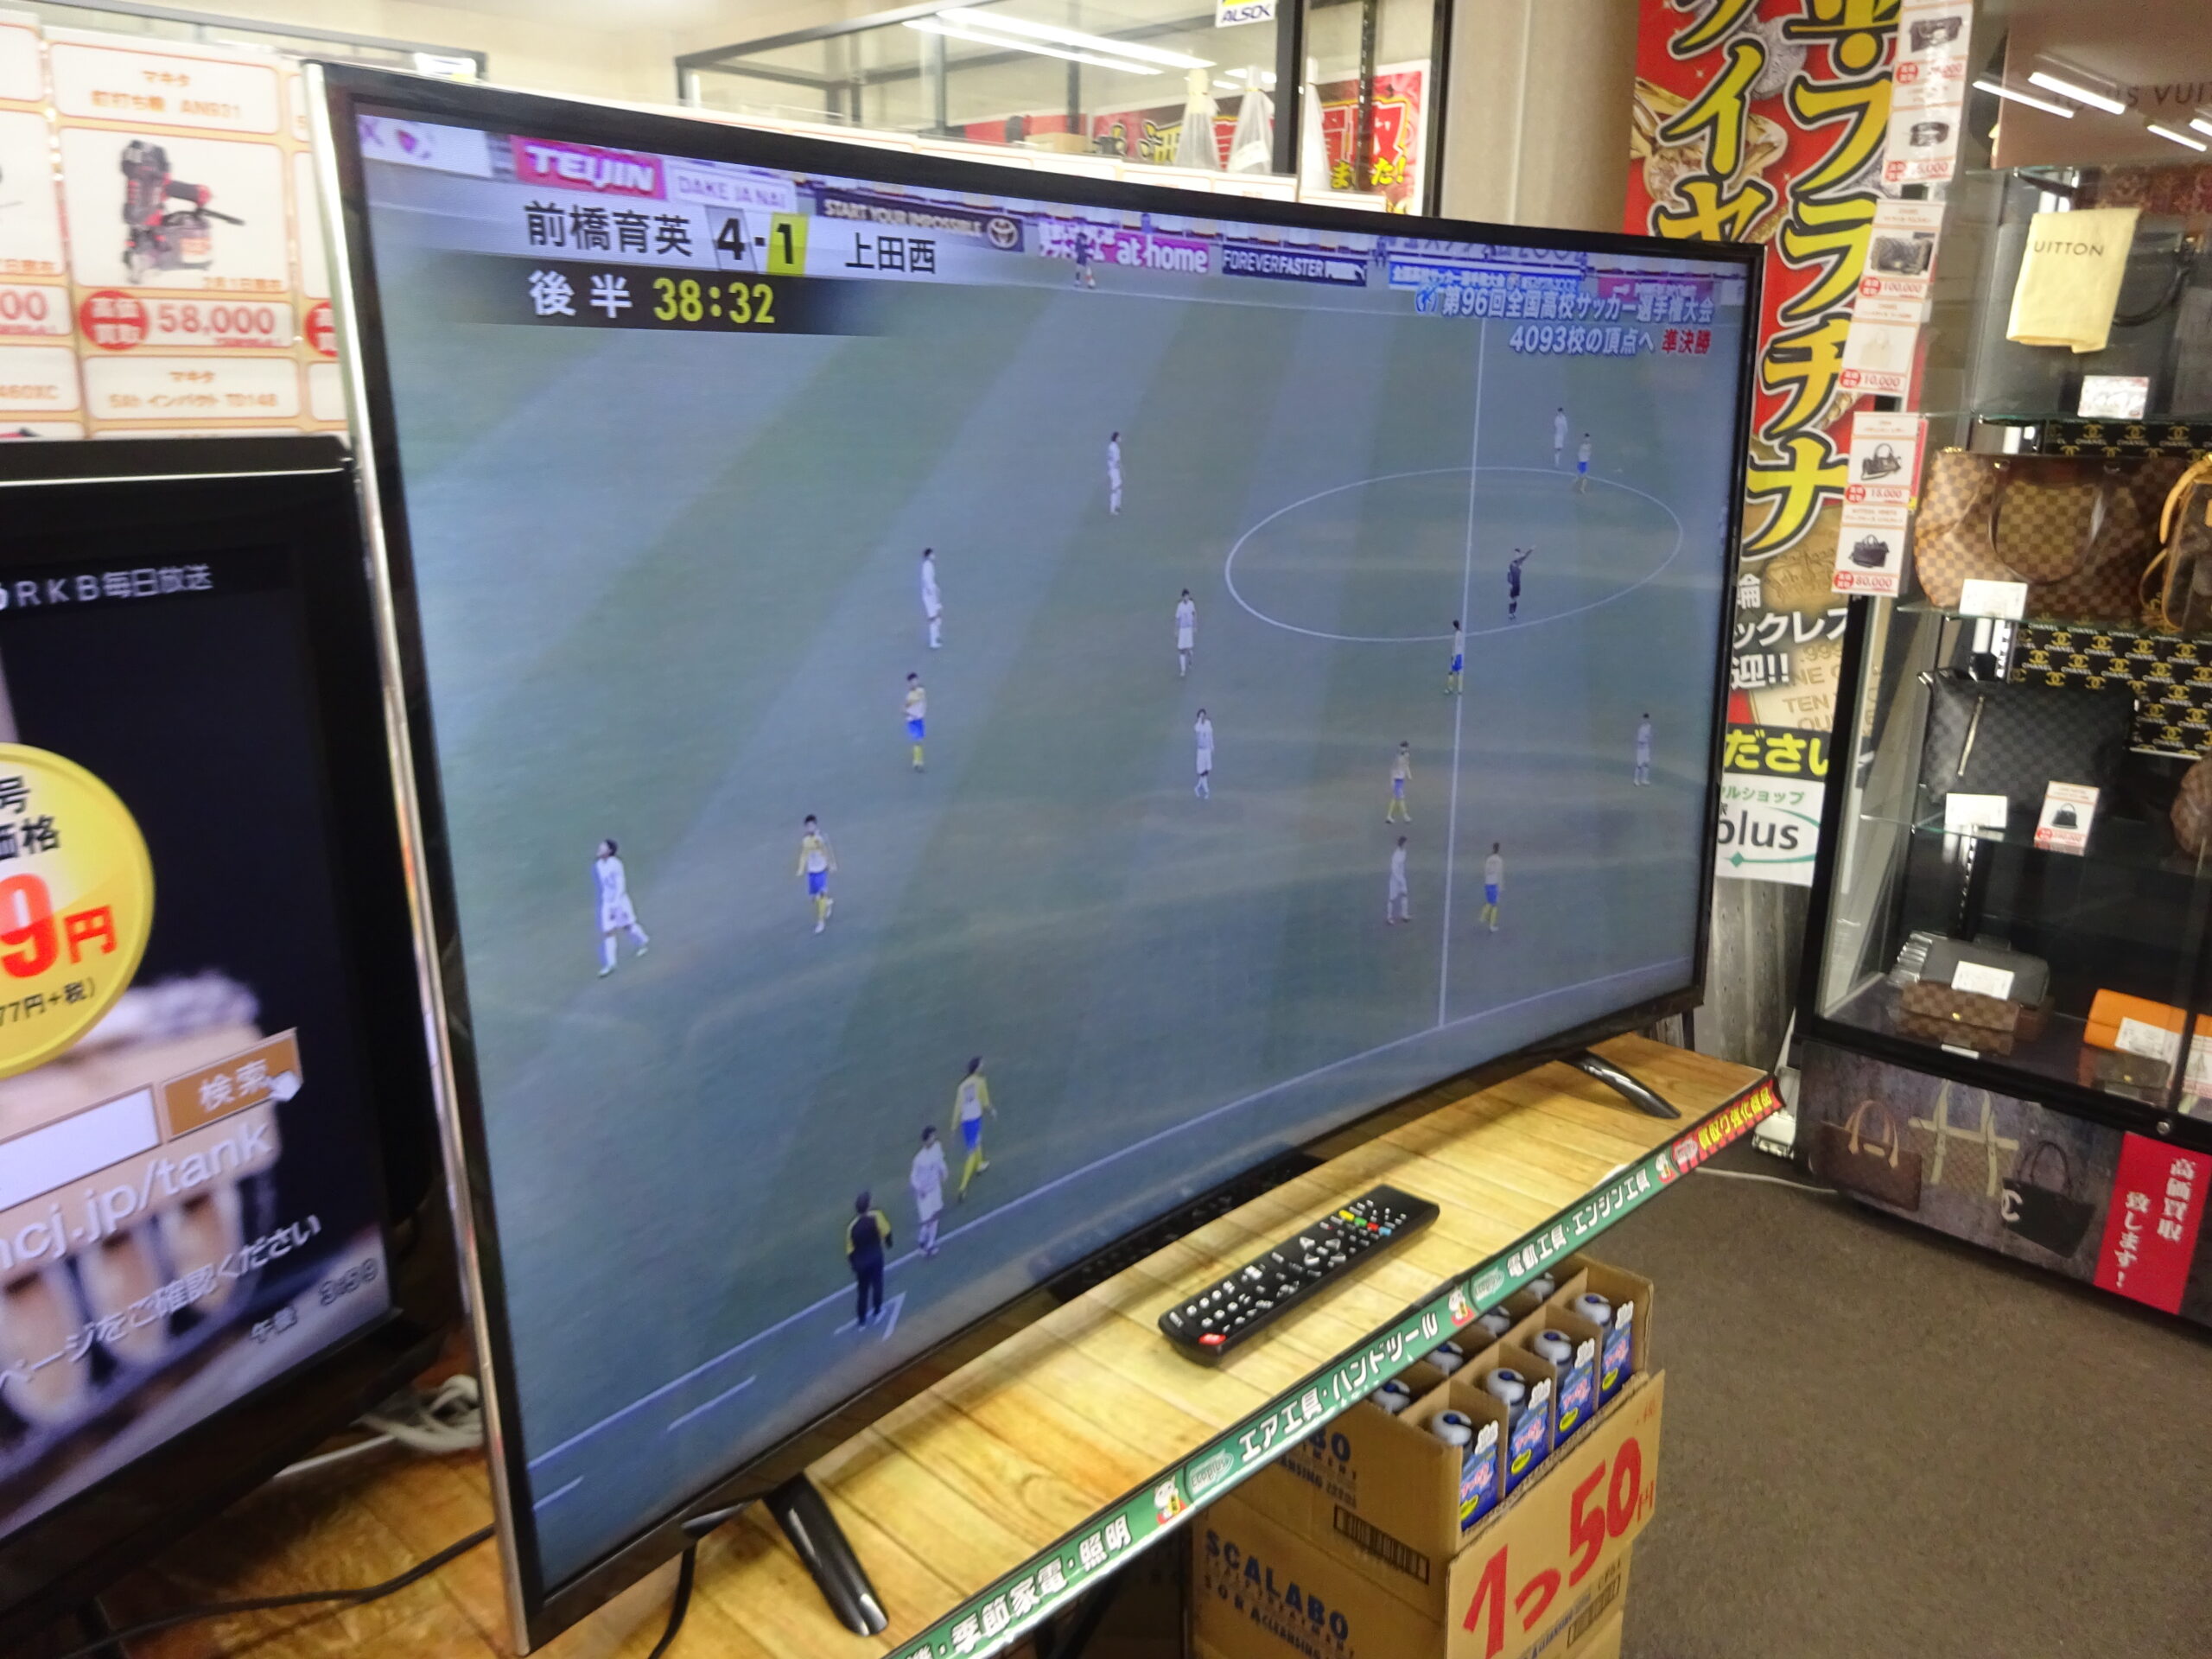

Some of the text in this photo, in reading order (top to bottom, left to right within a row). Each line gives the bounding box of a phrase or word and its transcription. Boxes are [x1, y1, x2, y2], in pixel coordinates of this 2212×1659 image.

[2154, 82, 2212, 105] VUI
[524, 143, 656, 192] TEIJIN
[524, 200, 693, 257] 前橋育英
[844, 232, 937, 275] 上田西
[1142, 232, 1209, 273] home
[2033, 240, 2105, 257] UITTON
[652, 276, 775, 324] 38:32
[1441, 285, 1714, 324] 第96回全国高校サッカー選手権大会
[1509, 325, 1713, 357] 4093校の頂点へ 準決勝
[1782, 691, 1830, 714] TEN
[1721, 785, 1806, 805] ルショップ
[198, 1056, 271, 1113] 検索
[1506, 1167, 1651, 1279] 電動工具・エンジン工具
[1238, 1312, 1440, 1463] エア工具・ハンドツール
[1206, 1529, 1349, 1642] SCALABO
